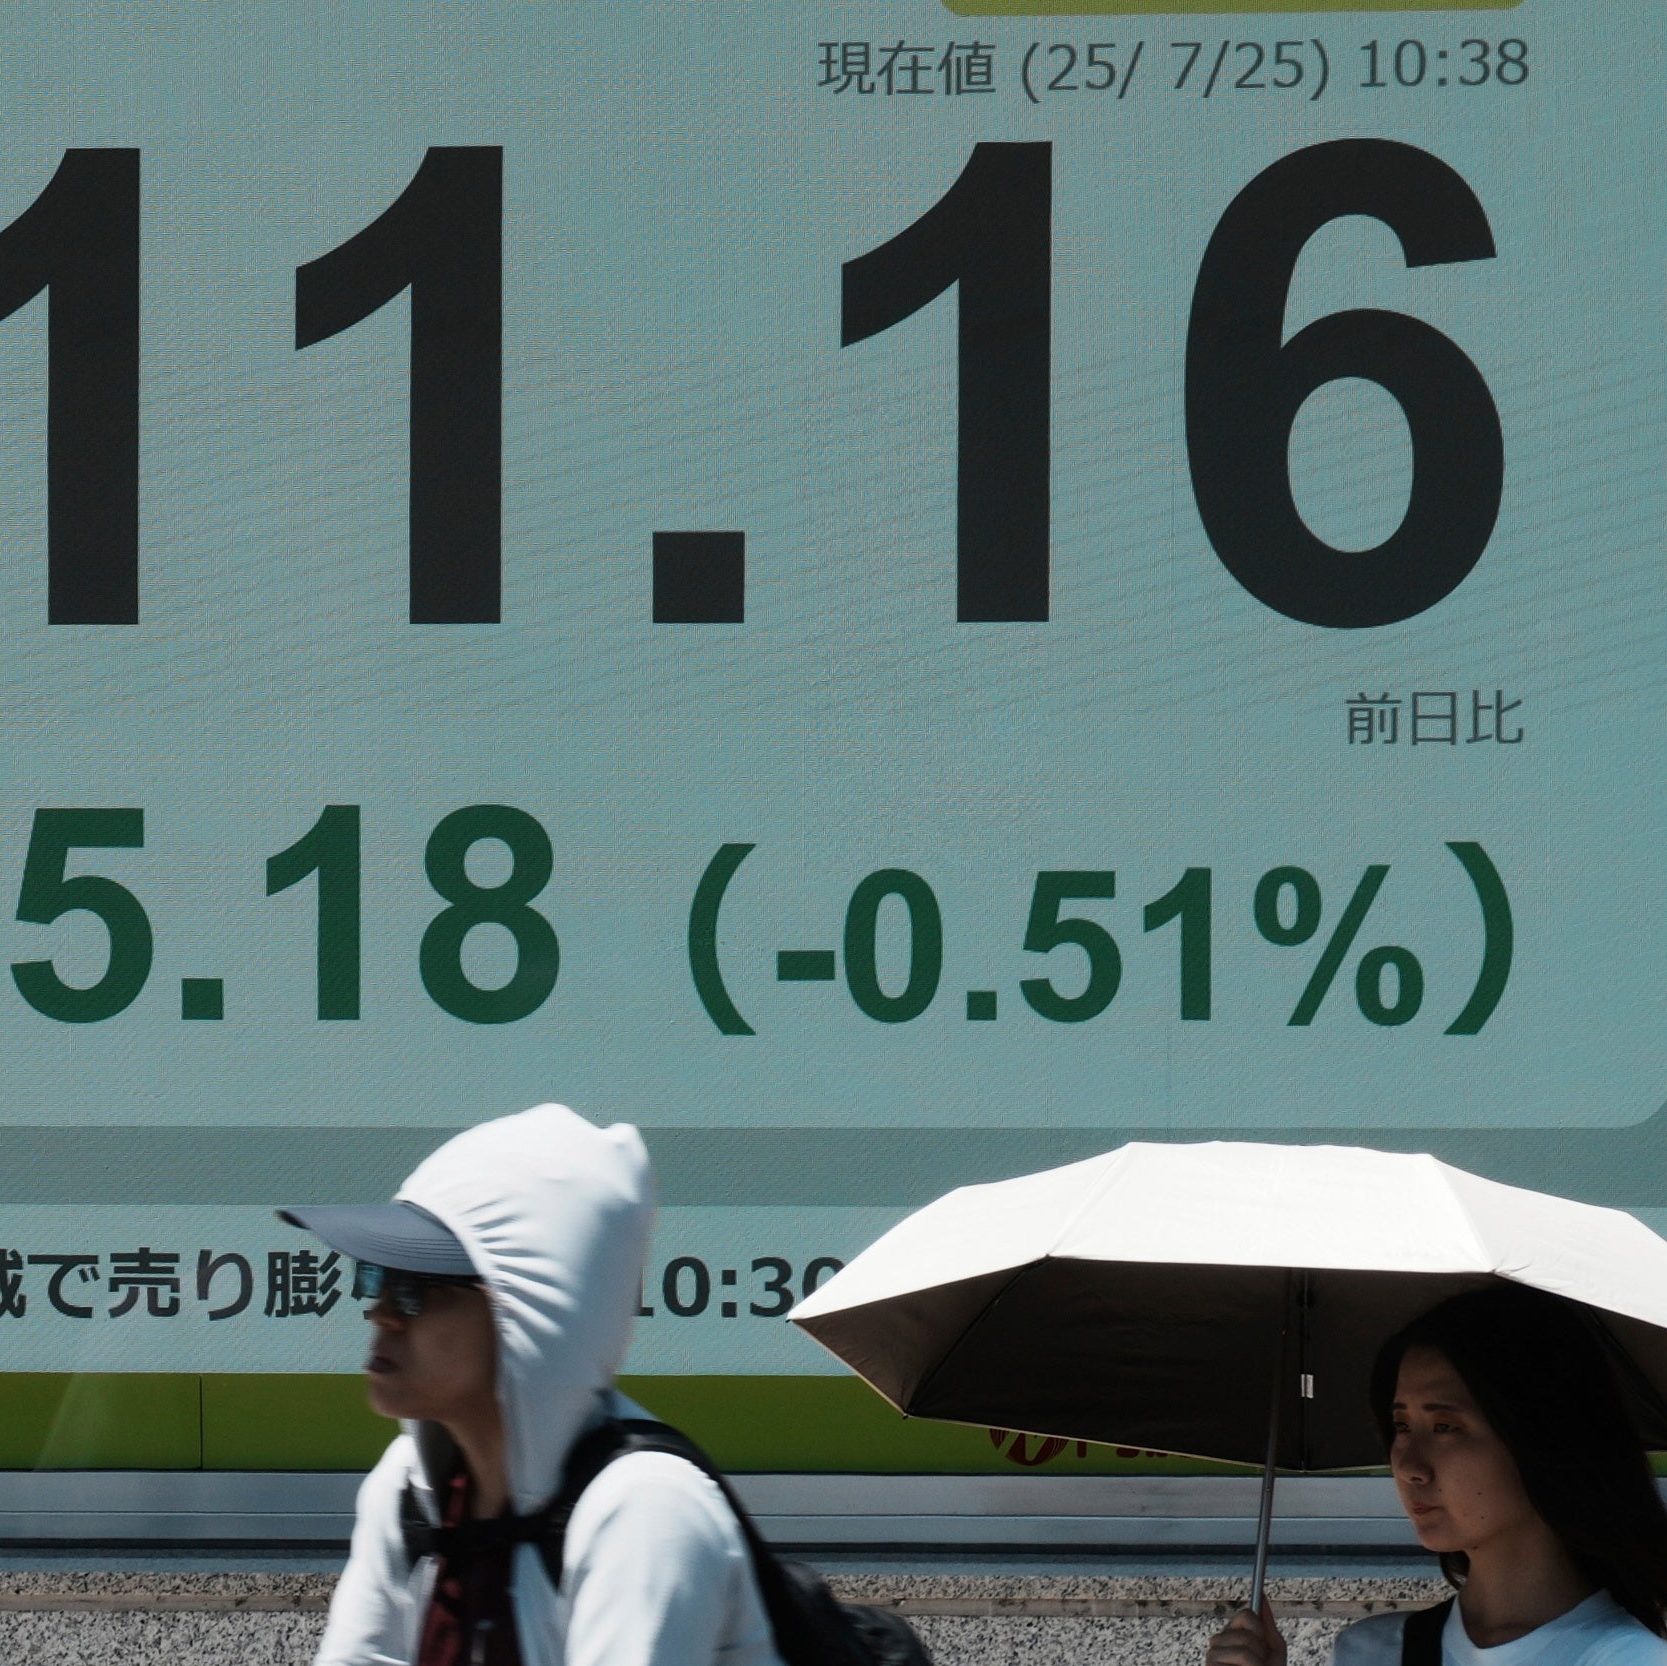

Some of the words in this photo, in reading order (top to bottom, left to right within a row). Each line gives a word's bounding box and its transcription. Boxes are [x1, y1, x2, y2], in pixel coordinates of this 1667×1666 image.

[818, 40, 996, 95] 現在値
[1022, 41, 1144, 104] (25/
[1171, 39, 1329, 101] 7/25)
[1361, 39, 1529, 88] 10:38
[1345, 690, 1523, 746] 前日比
[687, 841, 1514, 1036] (-0.51%)
